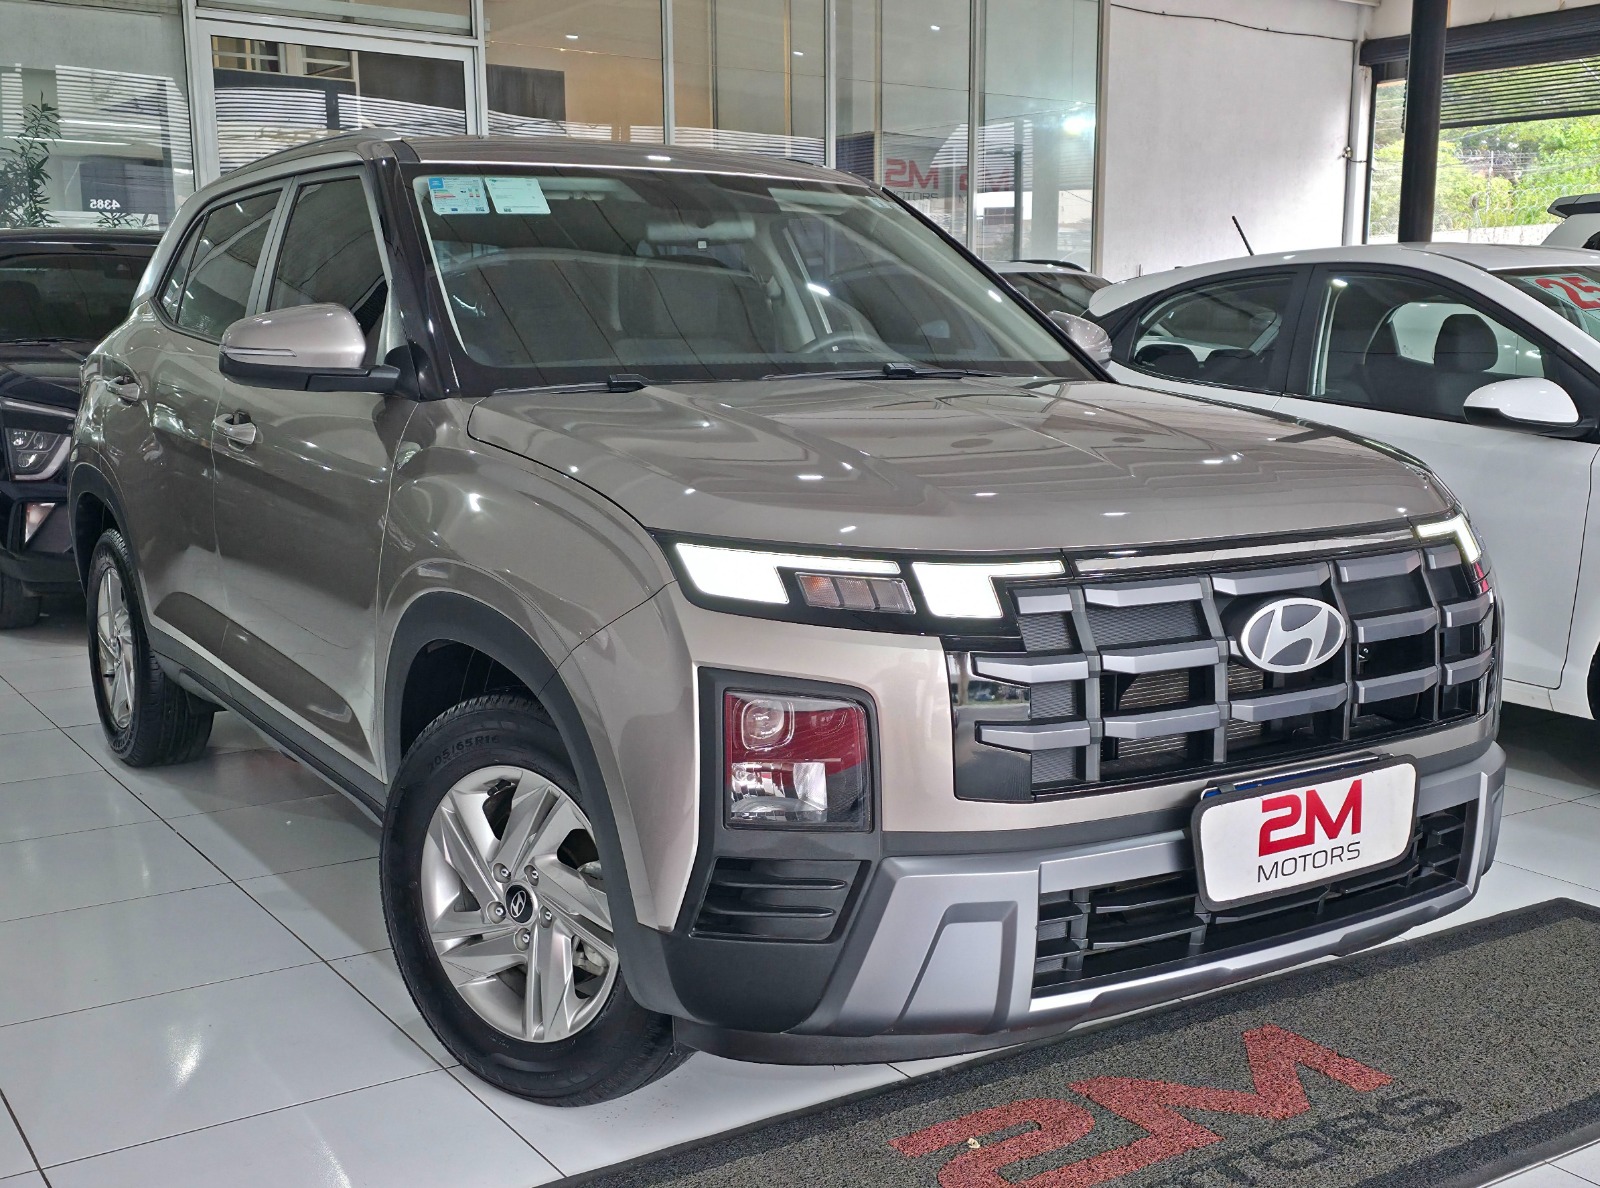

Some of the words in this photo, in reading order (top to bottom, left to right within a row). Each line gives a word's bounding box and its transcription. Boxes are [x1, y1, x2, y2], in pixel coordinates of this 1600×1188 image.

[885, 158, 939, 189] 2M
[893, 190, 939, 200] OTORS
[1258, 779, 1363, 857] 2M
[1257, 841, 1362, 882] MOTORS
[888, 1024, 1394, 1188] 2M
